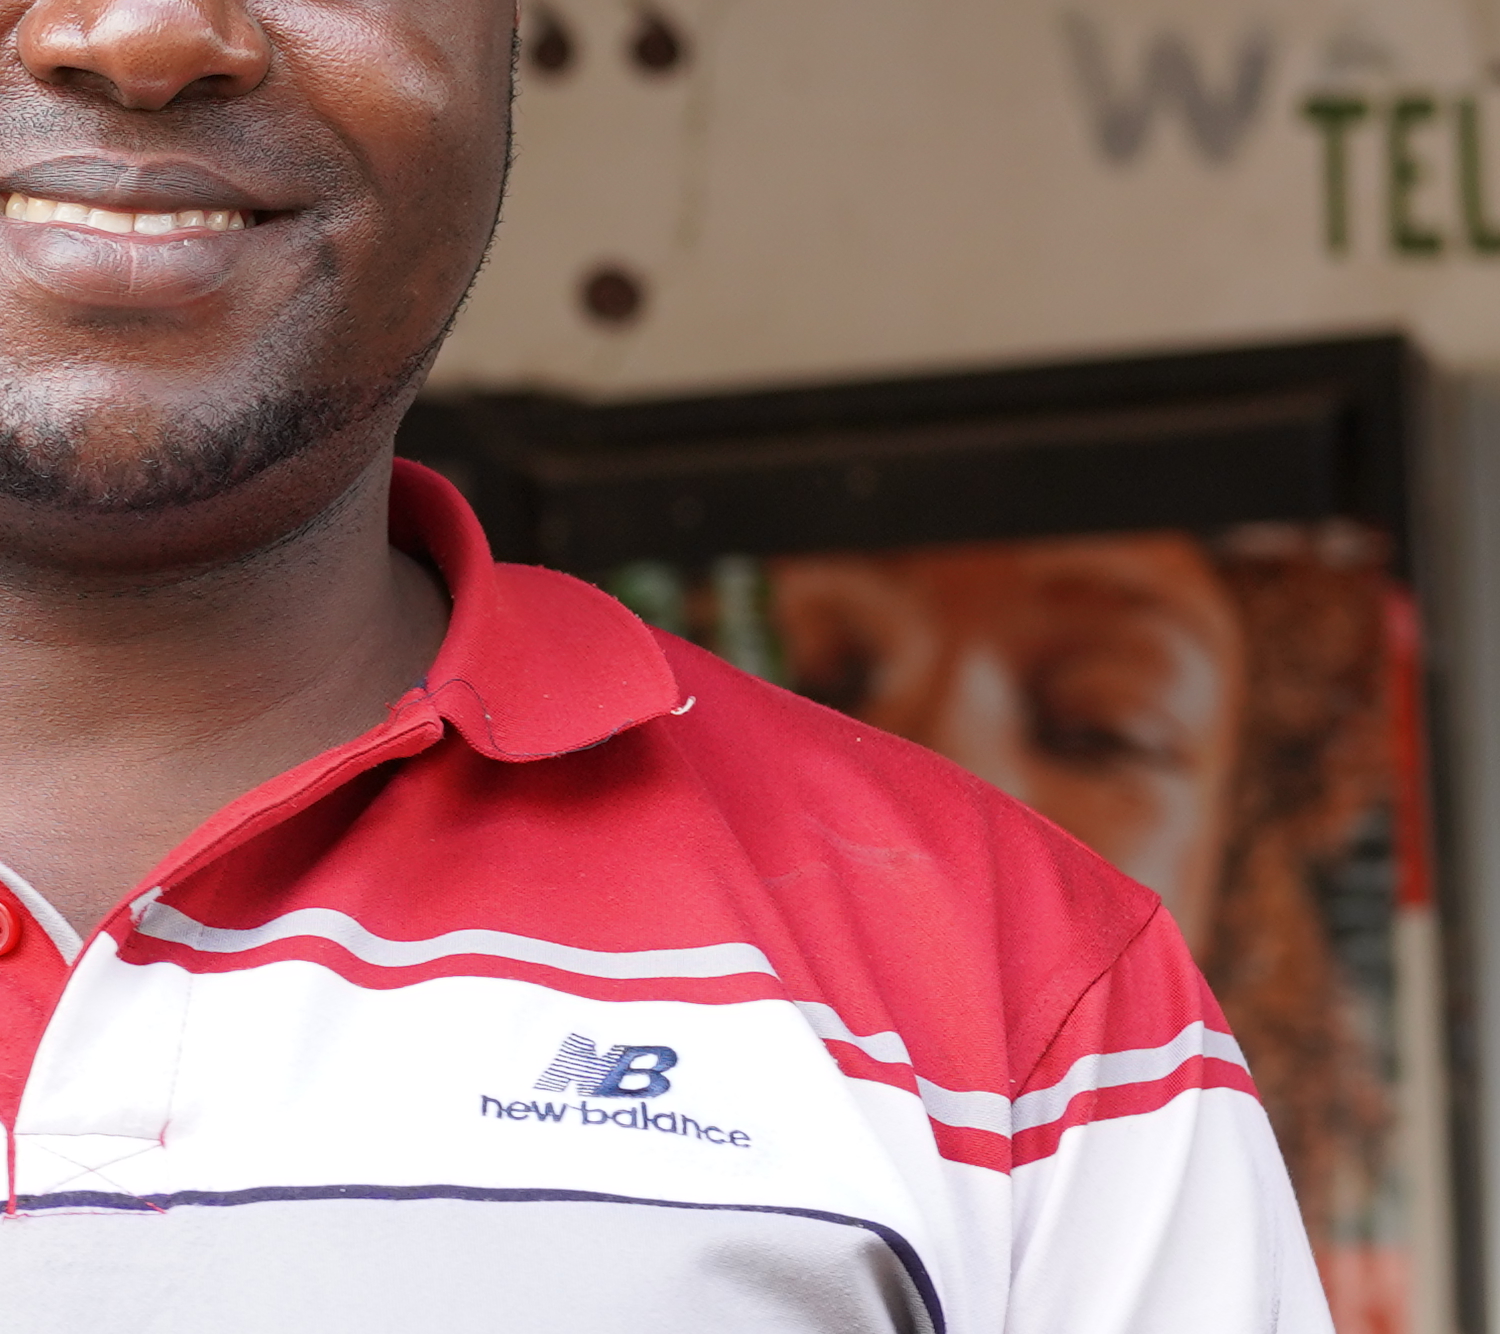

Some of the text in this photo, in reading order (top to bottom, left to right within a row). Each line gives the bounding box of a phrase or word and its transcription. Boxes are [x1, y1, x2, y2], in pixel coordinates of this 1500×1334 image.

[532, 1031, 679, 1099] NB
[480, 1093, 752, 1149] new balance
